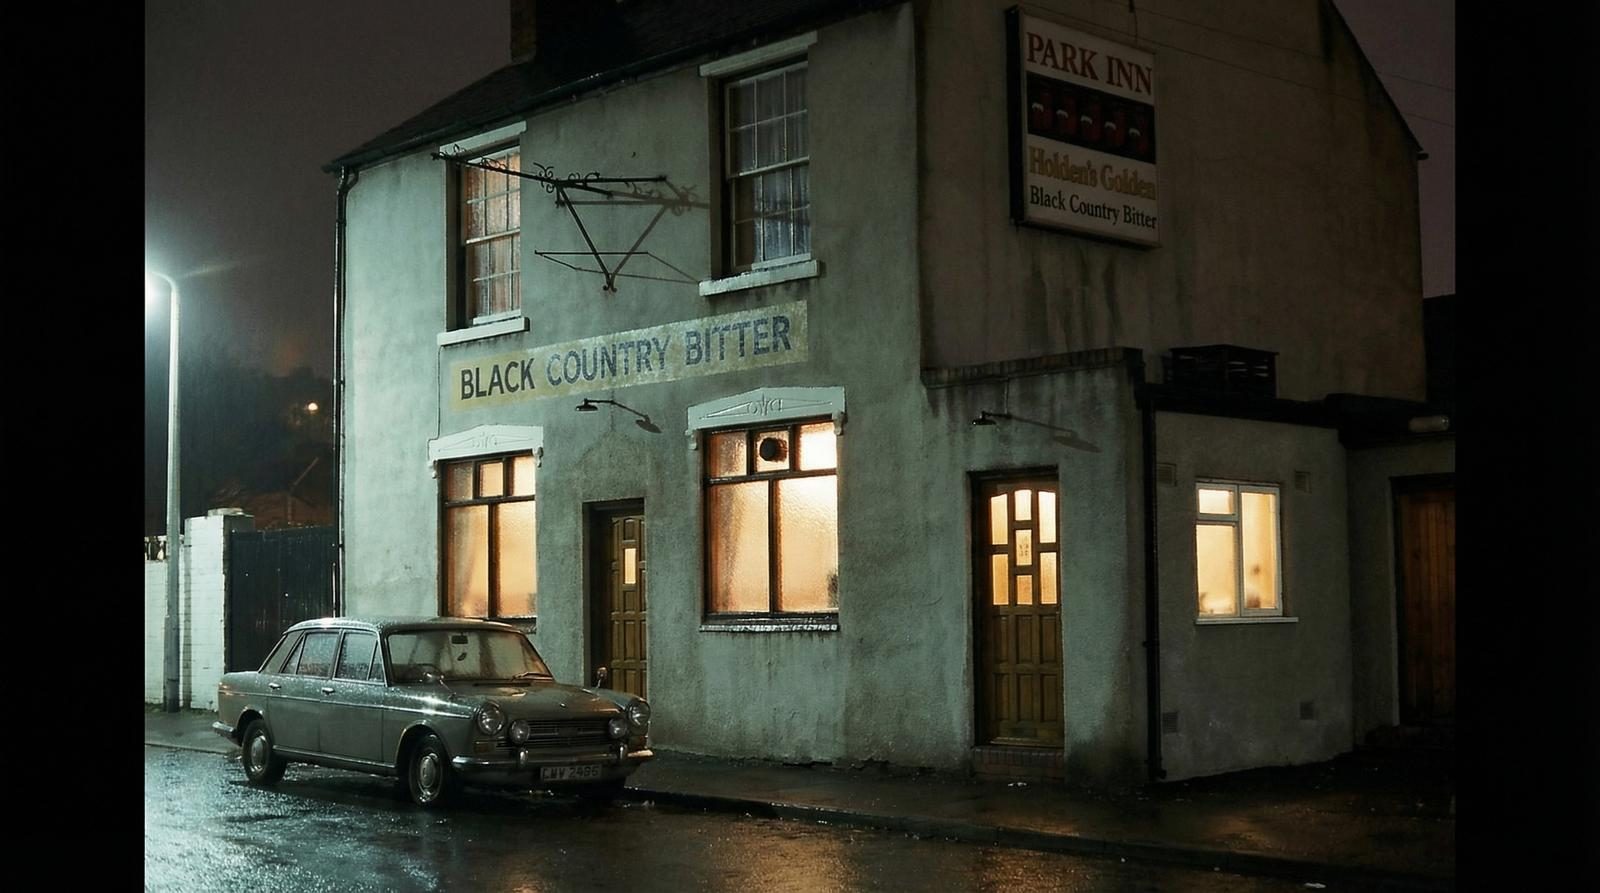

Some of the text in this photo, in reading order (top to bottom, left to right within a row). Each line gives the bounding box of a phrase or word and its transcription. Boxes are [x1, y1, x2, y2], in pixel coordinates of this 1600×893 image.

[1026, 31, 1153, 96] PARK INN
[1029, 147, 1157, 201] Holden's Golden
[1030, 185, 1157, 230] Black Country Bitter
[460, 315, 792, 401] BLACK COUNTRY BITTER
